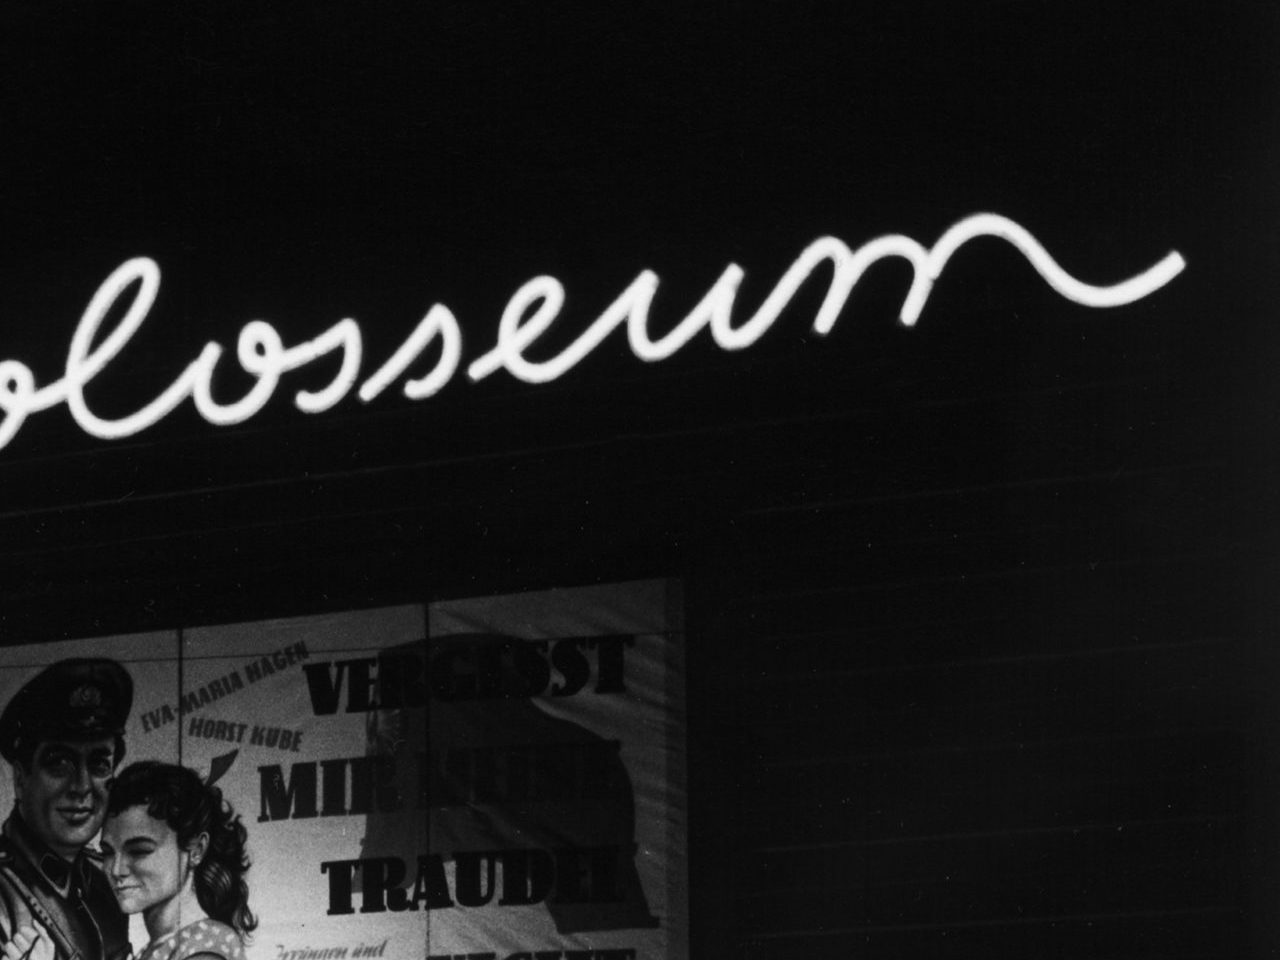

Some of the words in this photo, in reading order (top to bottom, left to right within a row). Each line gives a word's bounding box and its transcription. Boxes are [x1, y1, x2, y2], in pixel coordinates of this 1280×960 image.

[141, 671, 244, 733] EVA-MARIA
[245, 640, 310, 684] HAGEN
[303, 633, 636, 714] VERGESST
[188, 717, 248, 743] HORST
[250, 726, 304, 752] KUBE
[257, 754, 403, 822] MIR
[323, 845, 625, 913] TRAUDEL
